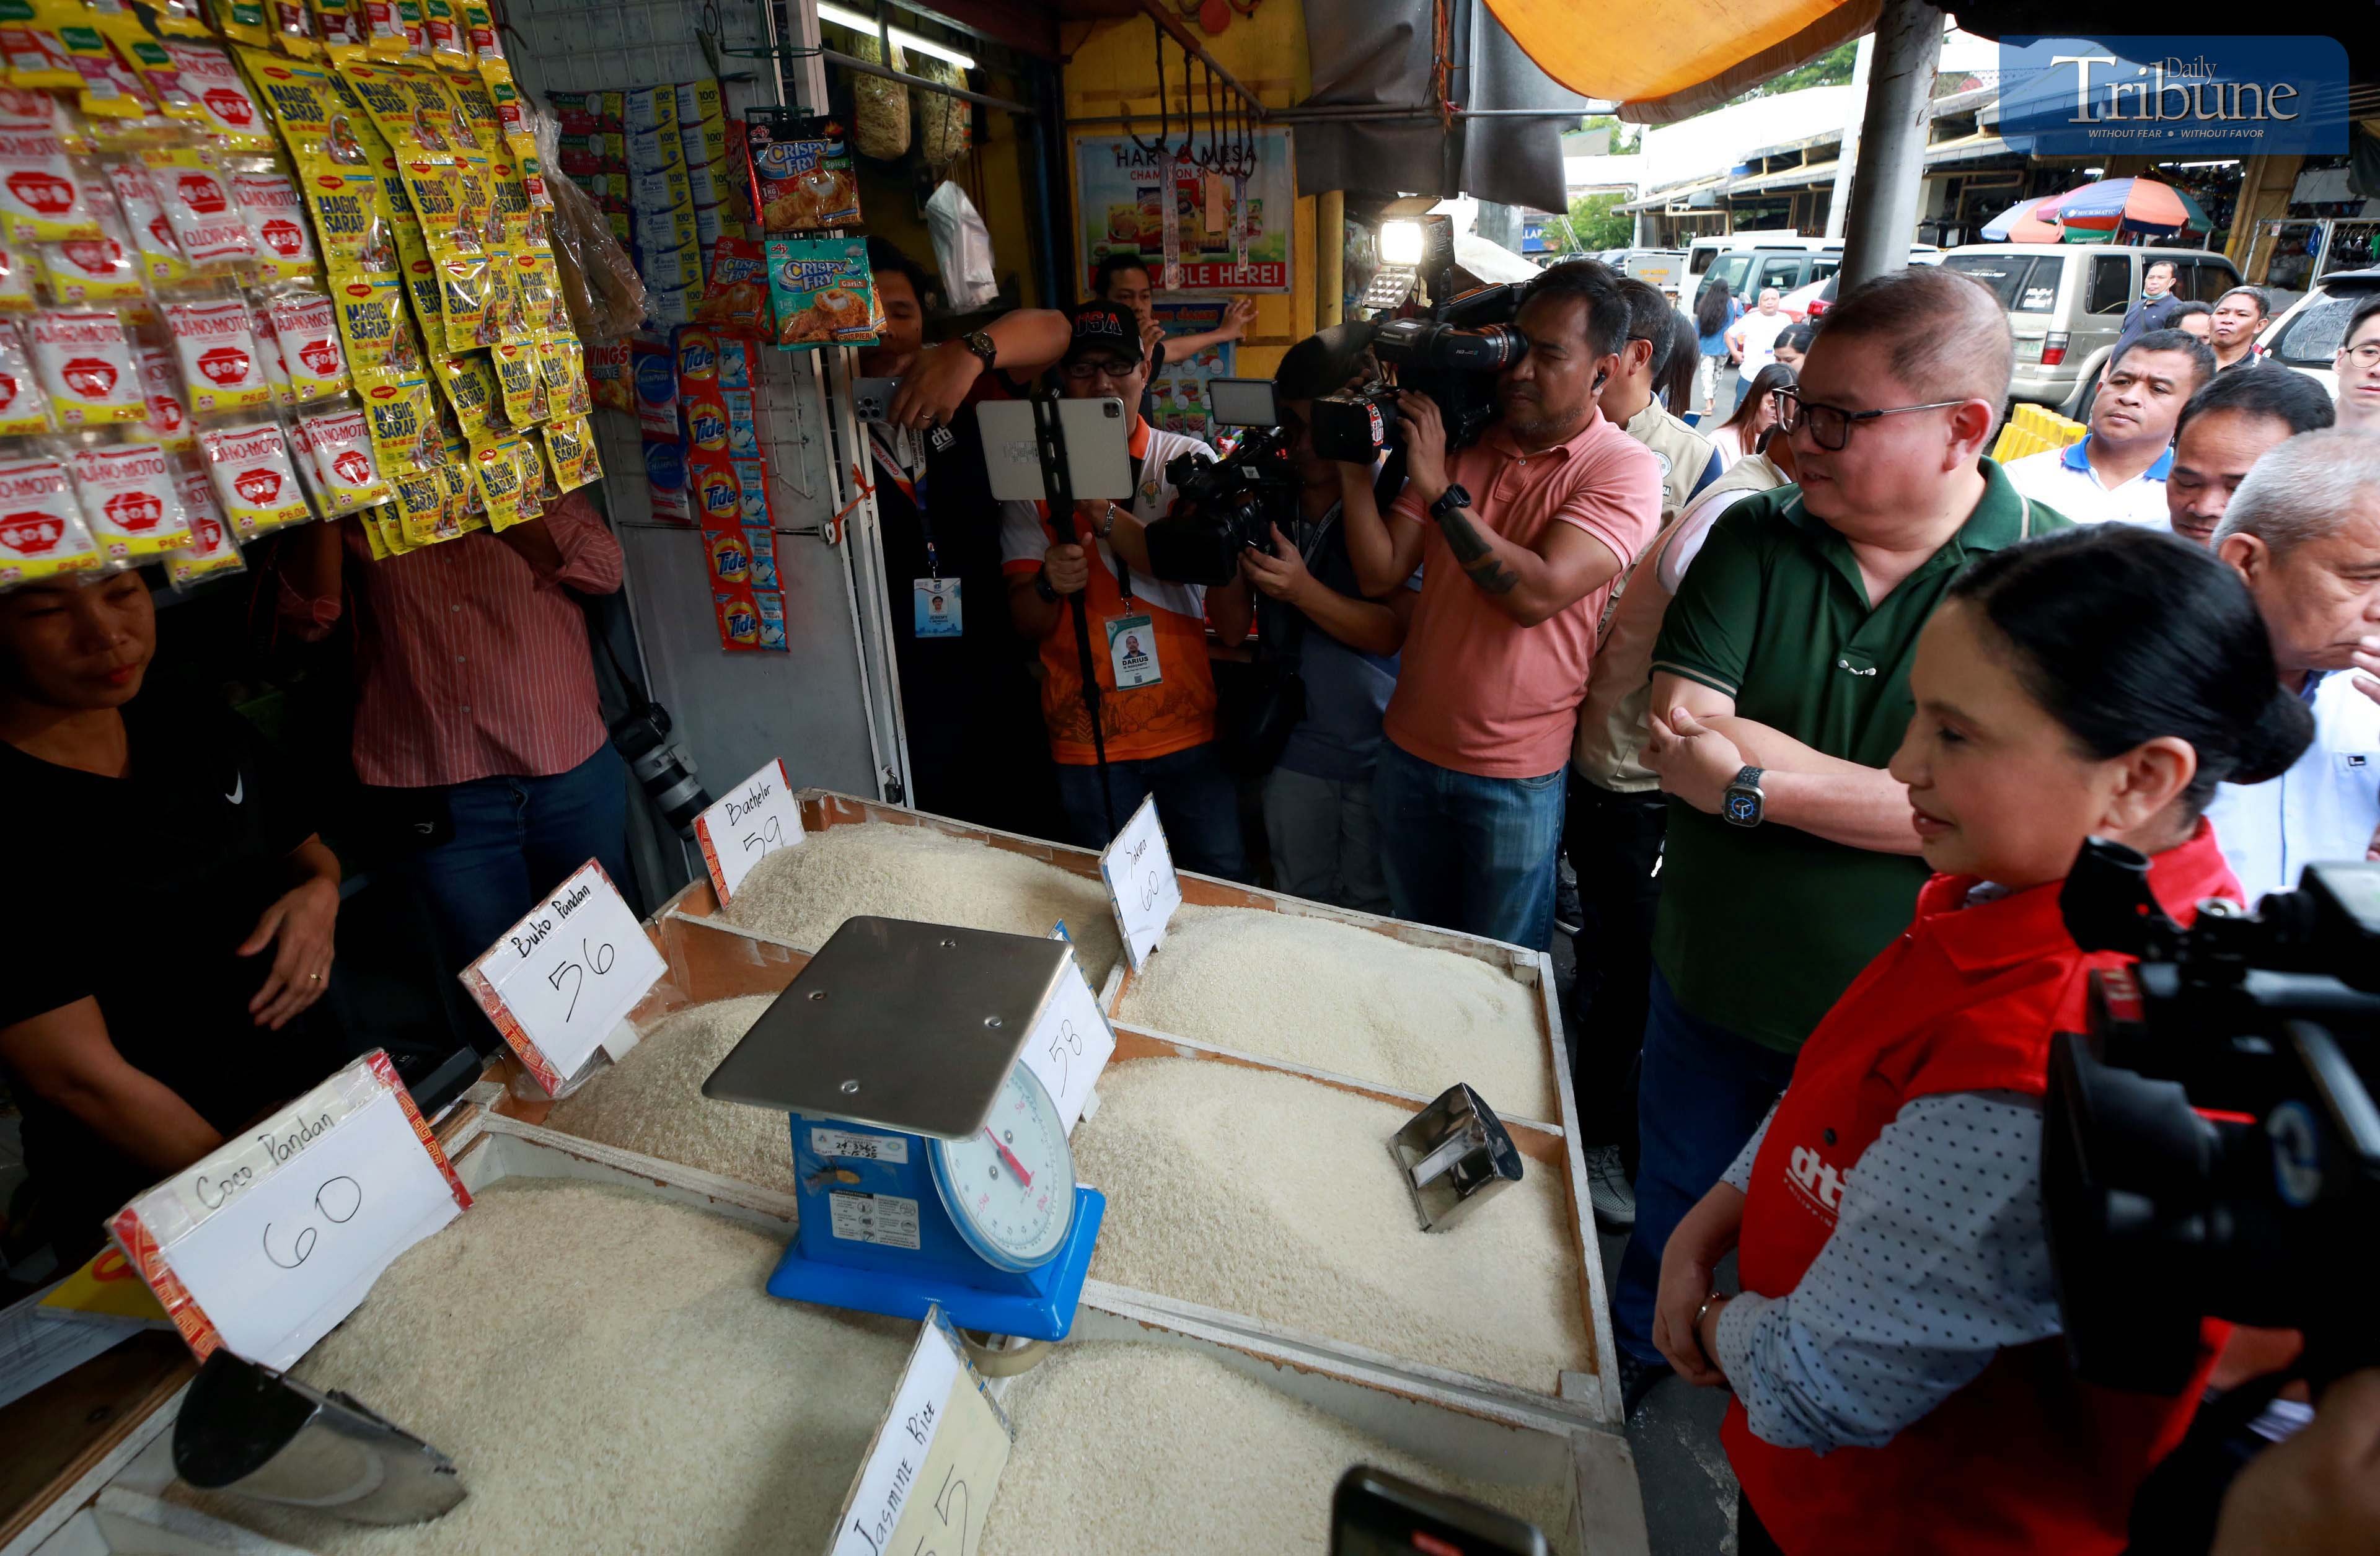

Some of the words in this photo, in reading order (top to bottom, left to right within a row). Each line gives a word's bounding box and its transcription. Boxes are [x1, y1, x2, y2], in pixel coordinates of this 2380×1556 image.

[767, 140, 829, 164] CRISPY
[785, 154, 817, 176] FRY
[826, 160, 847, 169] Spicy
[1130, 169, 1193, 180] CHAMON
[412, 180, 449, 196] MAGIC
[495, 182, 524, 198] MAGIC
[317, 196, 361, 214] MAGIC
[420, 197, 454, 214] SARAP
[500, 196, 528, 213] SARAP
[324, 214, 365, 234] SARAP
[519, 271, 546, 288] MAGIC
[784, 260, 846, 279] CRISPY
[1219, 265, 1279, 285] HERE!
[803, 273, 834, 292] FRY
[345, 302, 387, 322] MAGIC
[173, 316, 250, 336] AJI-NO-MOTO
[349, 320, 391, 340] SARAP
[1074, 311, 1122, 337] USA
[585, 345, 630, 367] WINGS
[681, 346, 715, 373] Tide
[501, 360, 527, 378] MAGIC
[449, 372, 480, 393] MAGIC
[505, 375, 531, 393] SARAP
[456, 388, 486, 409] SARAP
[372, 401, 415, 423] MAGIC
[377, 418, 417, 439] SARAP
[692, 417, 725, 444] Tide
[554, 444, 582, 464] SARAP
[77, 459, 165, 483] AJI-NO-MOTO
[480, 462, 513, 483] MAGIC
[397, 477, 436, 499] MAGIC
[486, 476, 518, 498] SARAP
[405, 493, 439, 513] SARAP
[704, 485, 736, 511] Tide
[278, 507, 307, 521] P6.00
[716, 550, 747, 576] Tide
[728, 613, 757, 638] Tide
[1122, 656, 1149, 666] DARIUS
[725, 782, 772, 827] Bachelor
[743, 815, 786, 858] 59
[1124, 836, 1148, 880] Sakura
[1139, 870, 1160, 912] 60
[511, 918, 553, 959] Buko
[552, 883, 591, 921] Pandan
[548, 936, 615, 1024] 56
[1048, 1018, 1083, 1099] 58
[195, 1166, 254, 1211] Coco
[263, 1111, 335, 1167] Pandan
[262, 1175, 363, 1270] 60
